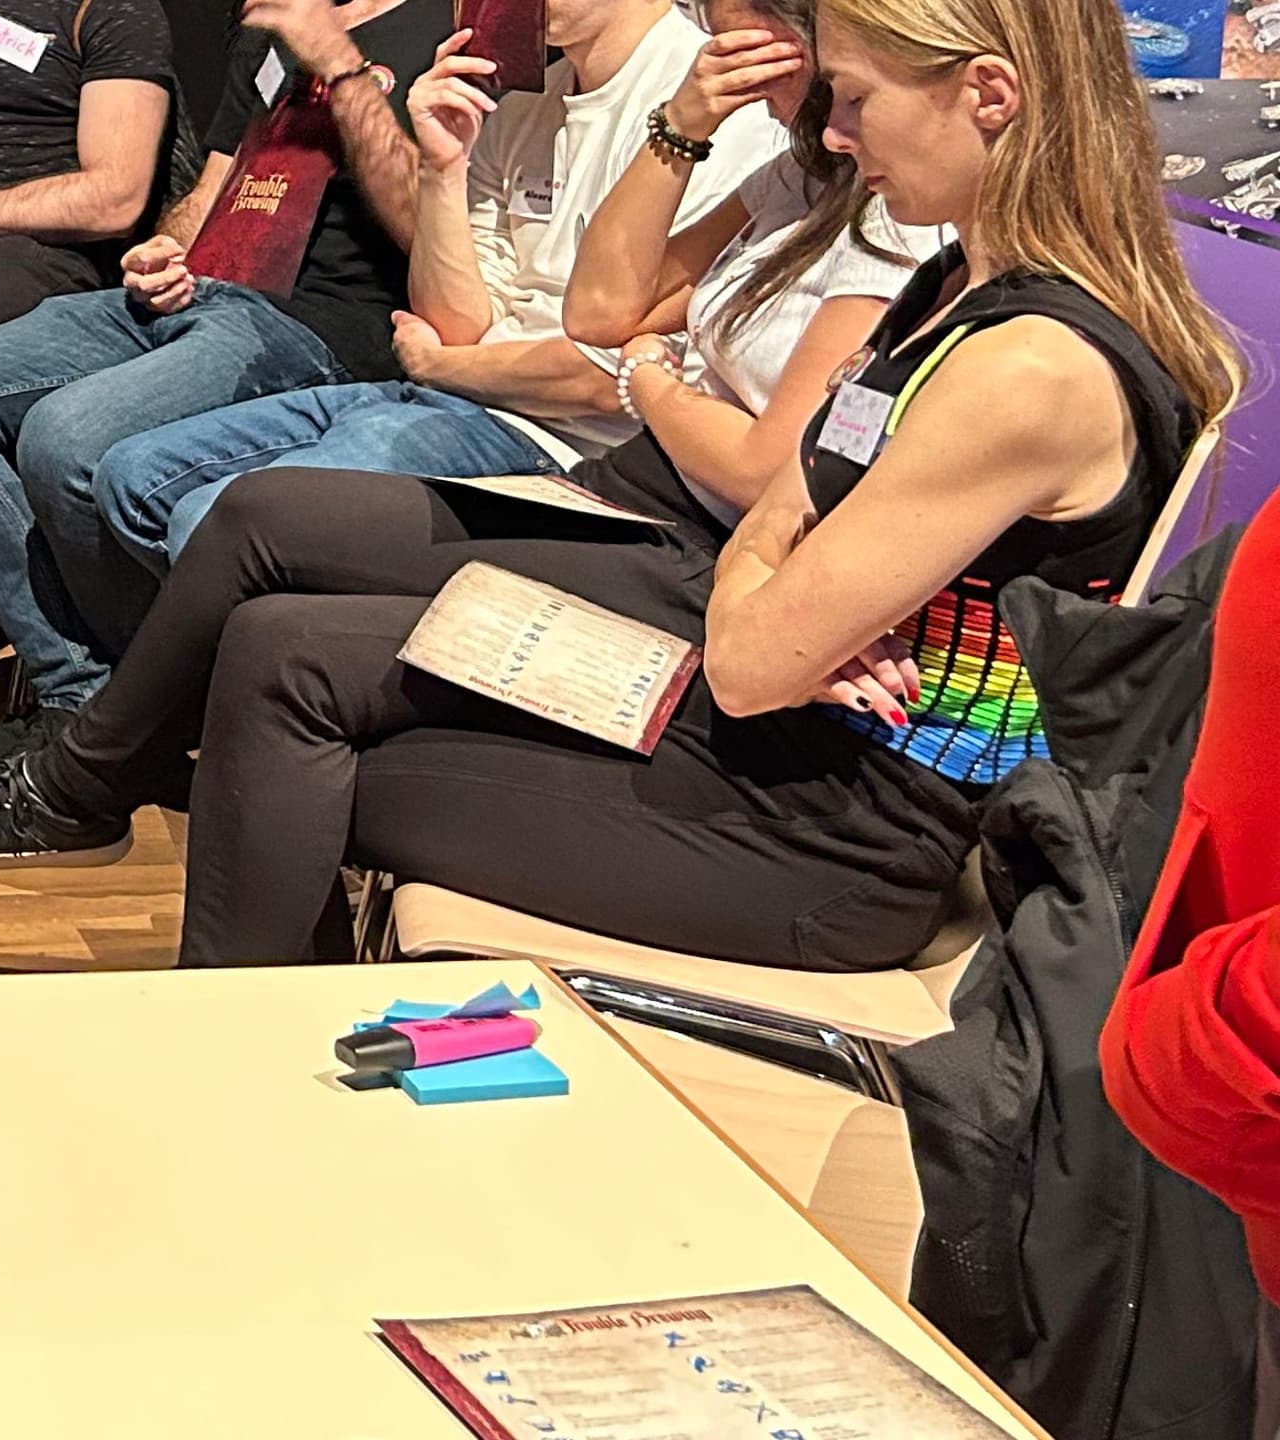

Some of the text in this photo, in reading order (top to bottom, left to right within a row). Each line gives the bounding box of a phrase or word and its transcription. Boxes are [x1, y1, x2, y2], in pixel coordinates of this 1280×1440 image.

[236, 174, 289, 198] Trouble
[560, 1309, 714, 1335] Trouble Brewing
